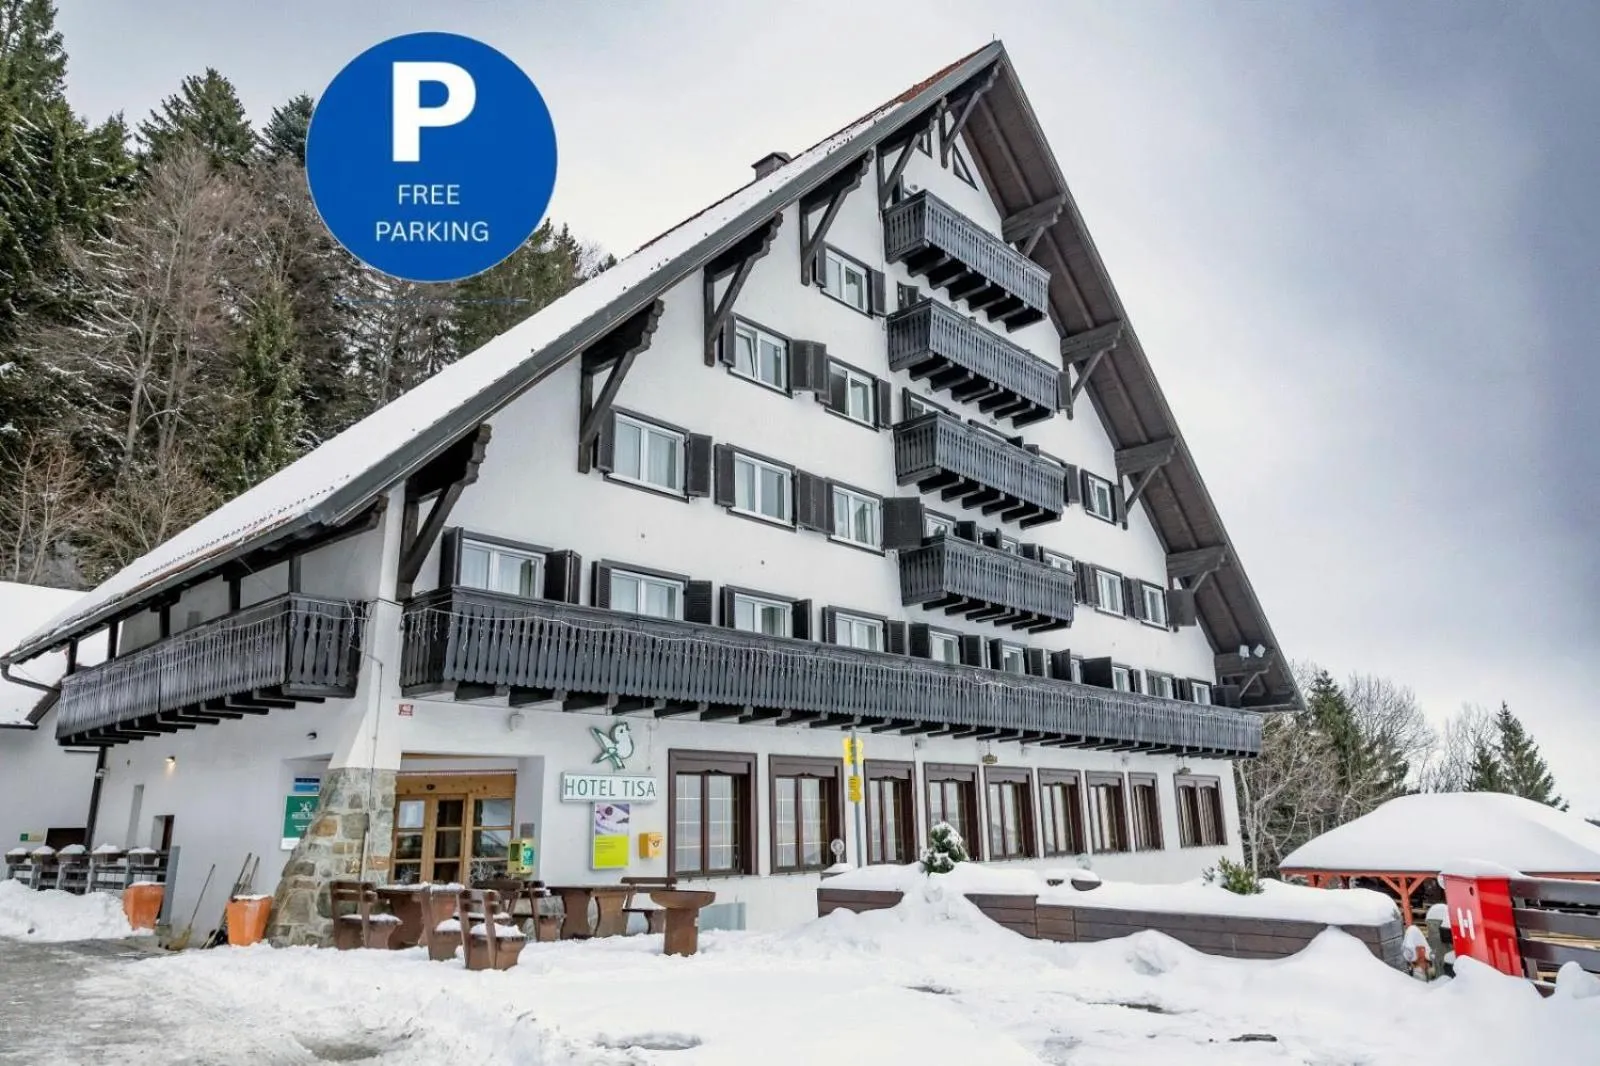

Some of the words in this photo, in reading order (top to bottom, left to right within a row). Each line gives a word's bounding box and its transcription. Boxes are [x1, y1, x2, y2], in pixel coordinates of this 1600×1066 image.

[564, 778, 616, 796] HOTEL
[622, 780, 656, 797] TISA
[1456, 907, 1476, 941] H
